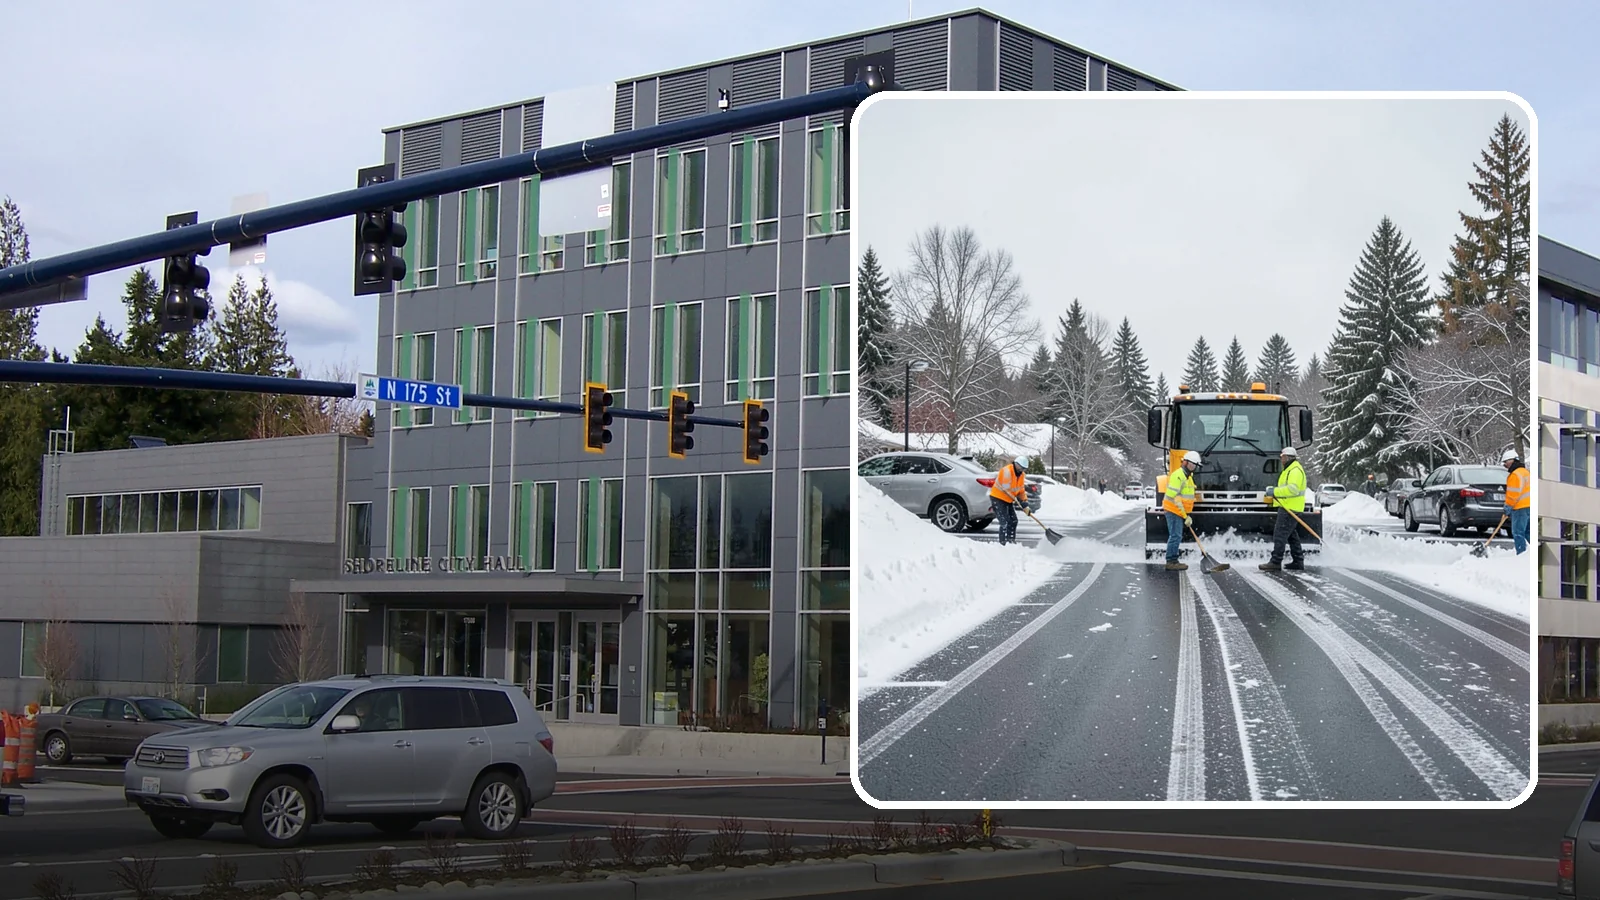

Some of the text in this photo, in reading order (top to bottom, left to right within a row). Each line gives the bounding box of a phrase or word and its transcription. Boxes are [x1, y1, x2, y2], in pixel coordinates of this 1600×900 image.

[387, 380, 451, 406] N 175 St
[344, 555, 527, 574] SHORELINE CITY HALL
